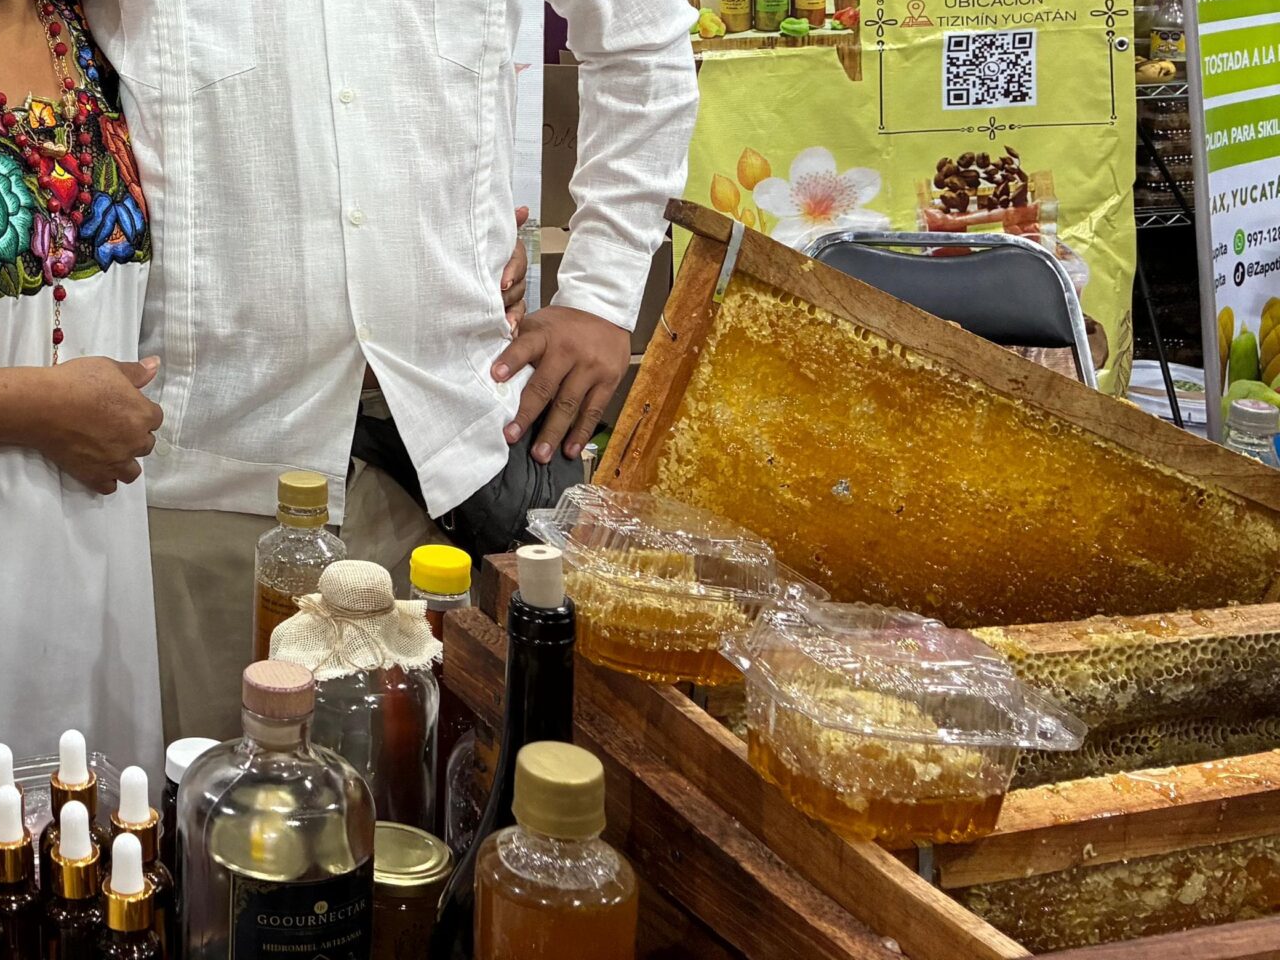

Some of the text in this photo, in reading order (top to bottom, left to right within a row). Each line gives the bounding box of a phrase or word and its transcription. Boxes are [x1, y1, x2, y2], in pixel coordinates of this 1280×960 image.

[936, 9, 1077, 27] TIZIMÍN YUCATÁN
[1204, 49, 1250, 75] TOSTADA
[1252, 48, 1260, 66] A
[1263, 45, 1275, 65] LA
[1231, 123, 1256, 145] PARA
